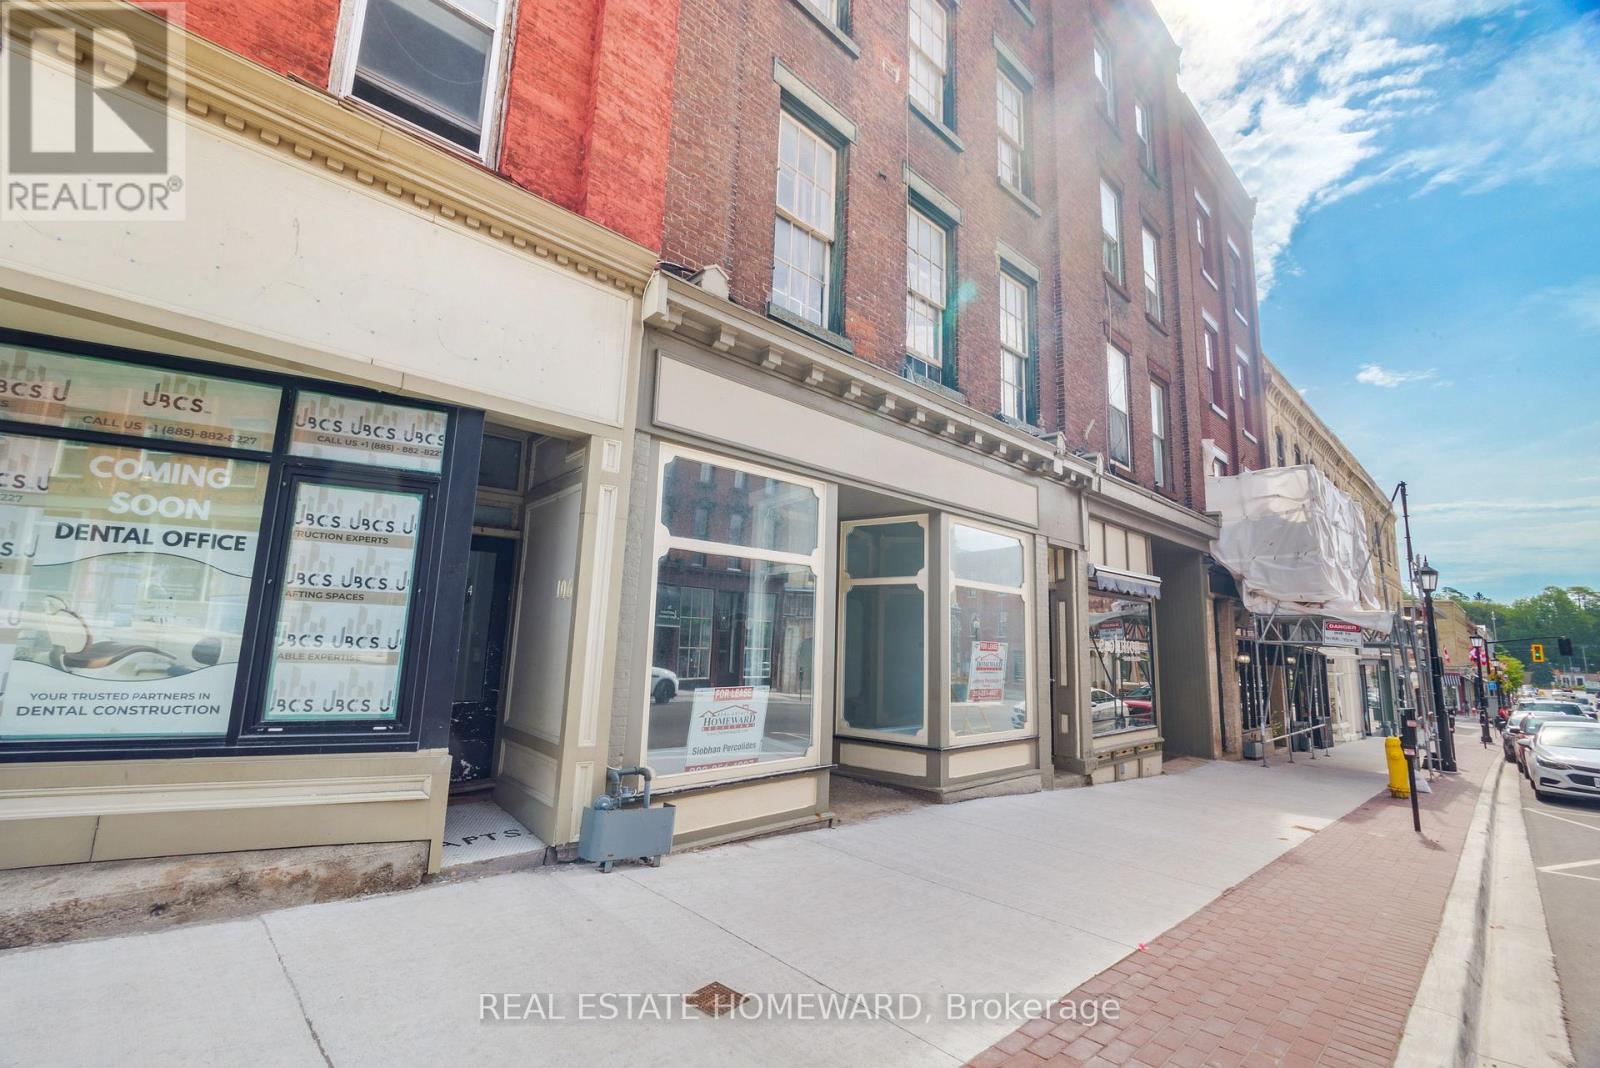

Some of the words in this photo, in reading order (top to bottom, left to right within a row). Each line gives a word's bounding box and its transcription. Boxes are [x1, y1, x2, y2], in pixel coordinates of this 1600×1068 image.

[142, 382, 204, 413] UBCS
[83, 415, 119, 428] CALL
[124, 421, 142, 430] US
[351, 415, 395, 440] UBCS
[317, 435, 342, 445] CALL
[345, 439, 358, 447] US
[89, 455, 231, 489] COMING
[107, 491, 211, 521] SOON
[350, 509, 395, 533] UBCS
[54, 522, 154, 545] DENTAL
[162, 530, 247, 551] OFFICE
[346, 535, 389, 544] EXPERTS
[341, 567, 387, 590] UBCS
[325, 592, 365, 601] SPACES
[30, 693, 67, 701] YOUR
[72, 693, 129, 701] TRUSTED
[132, 693, 195, 701] PARTNERS
[323, 690, 371, 712] UBCS
[715, 689, 730, 700] FOR
[731, 687, 752, 698] LEASE
[16, 706, 87, 716] DENTAL
[93, 705, 220, 716] CONSTRUCTION
[692, 744, 721, 756] Siobhan
